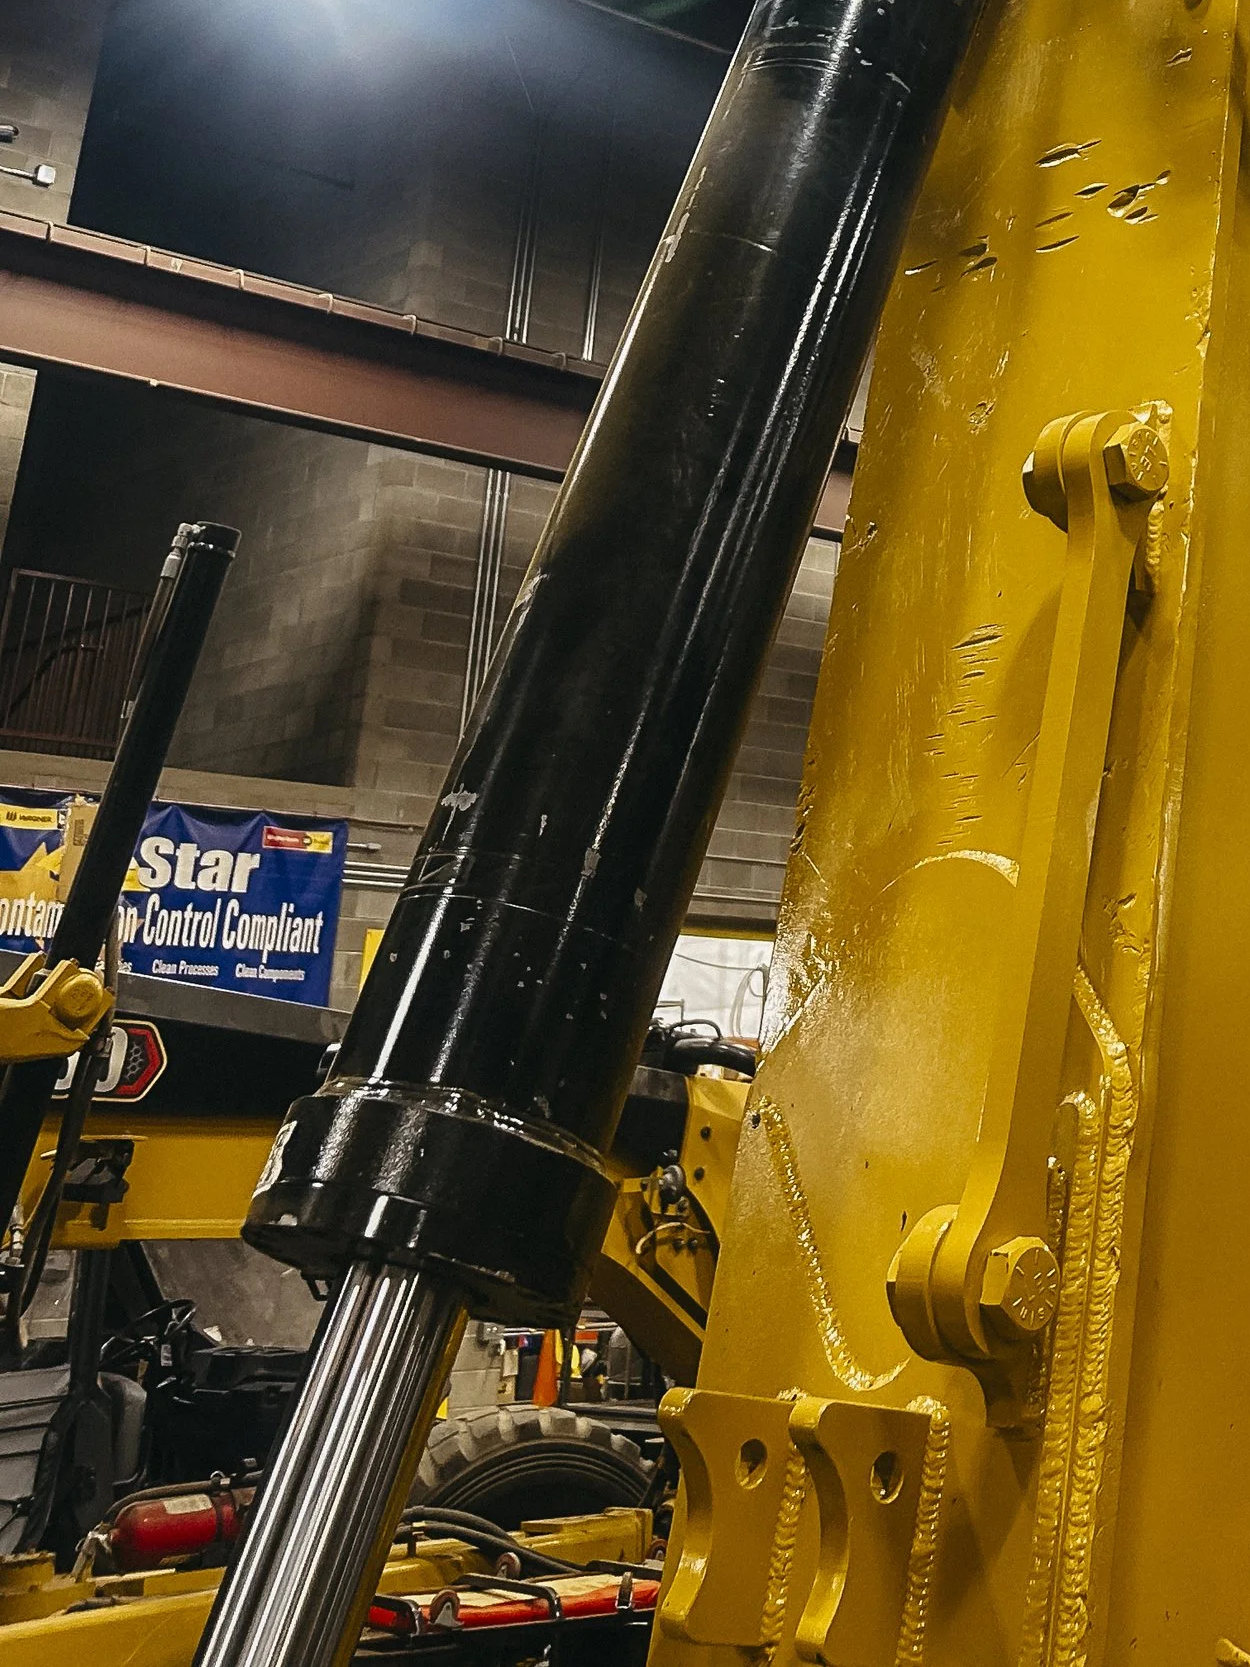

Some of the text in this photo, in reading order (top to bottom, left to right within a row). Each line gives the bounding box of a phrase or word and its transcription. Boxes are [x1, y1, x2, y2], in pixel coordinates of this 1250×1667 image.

[138, 836, 260, 893] Star
[142, 893, 222, 949] Control
[221, 898, 324, 964] Compliant
[152, 959, 177, 974] Clean
[178, 960, 220, 977] Processes
